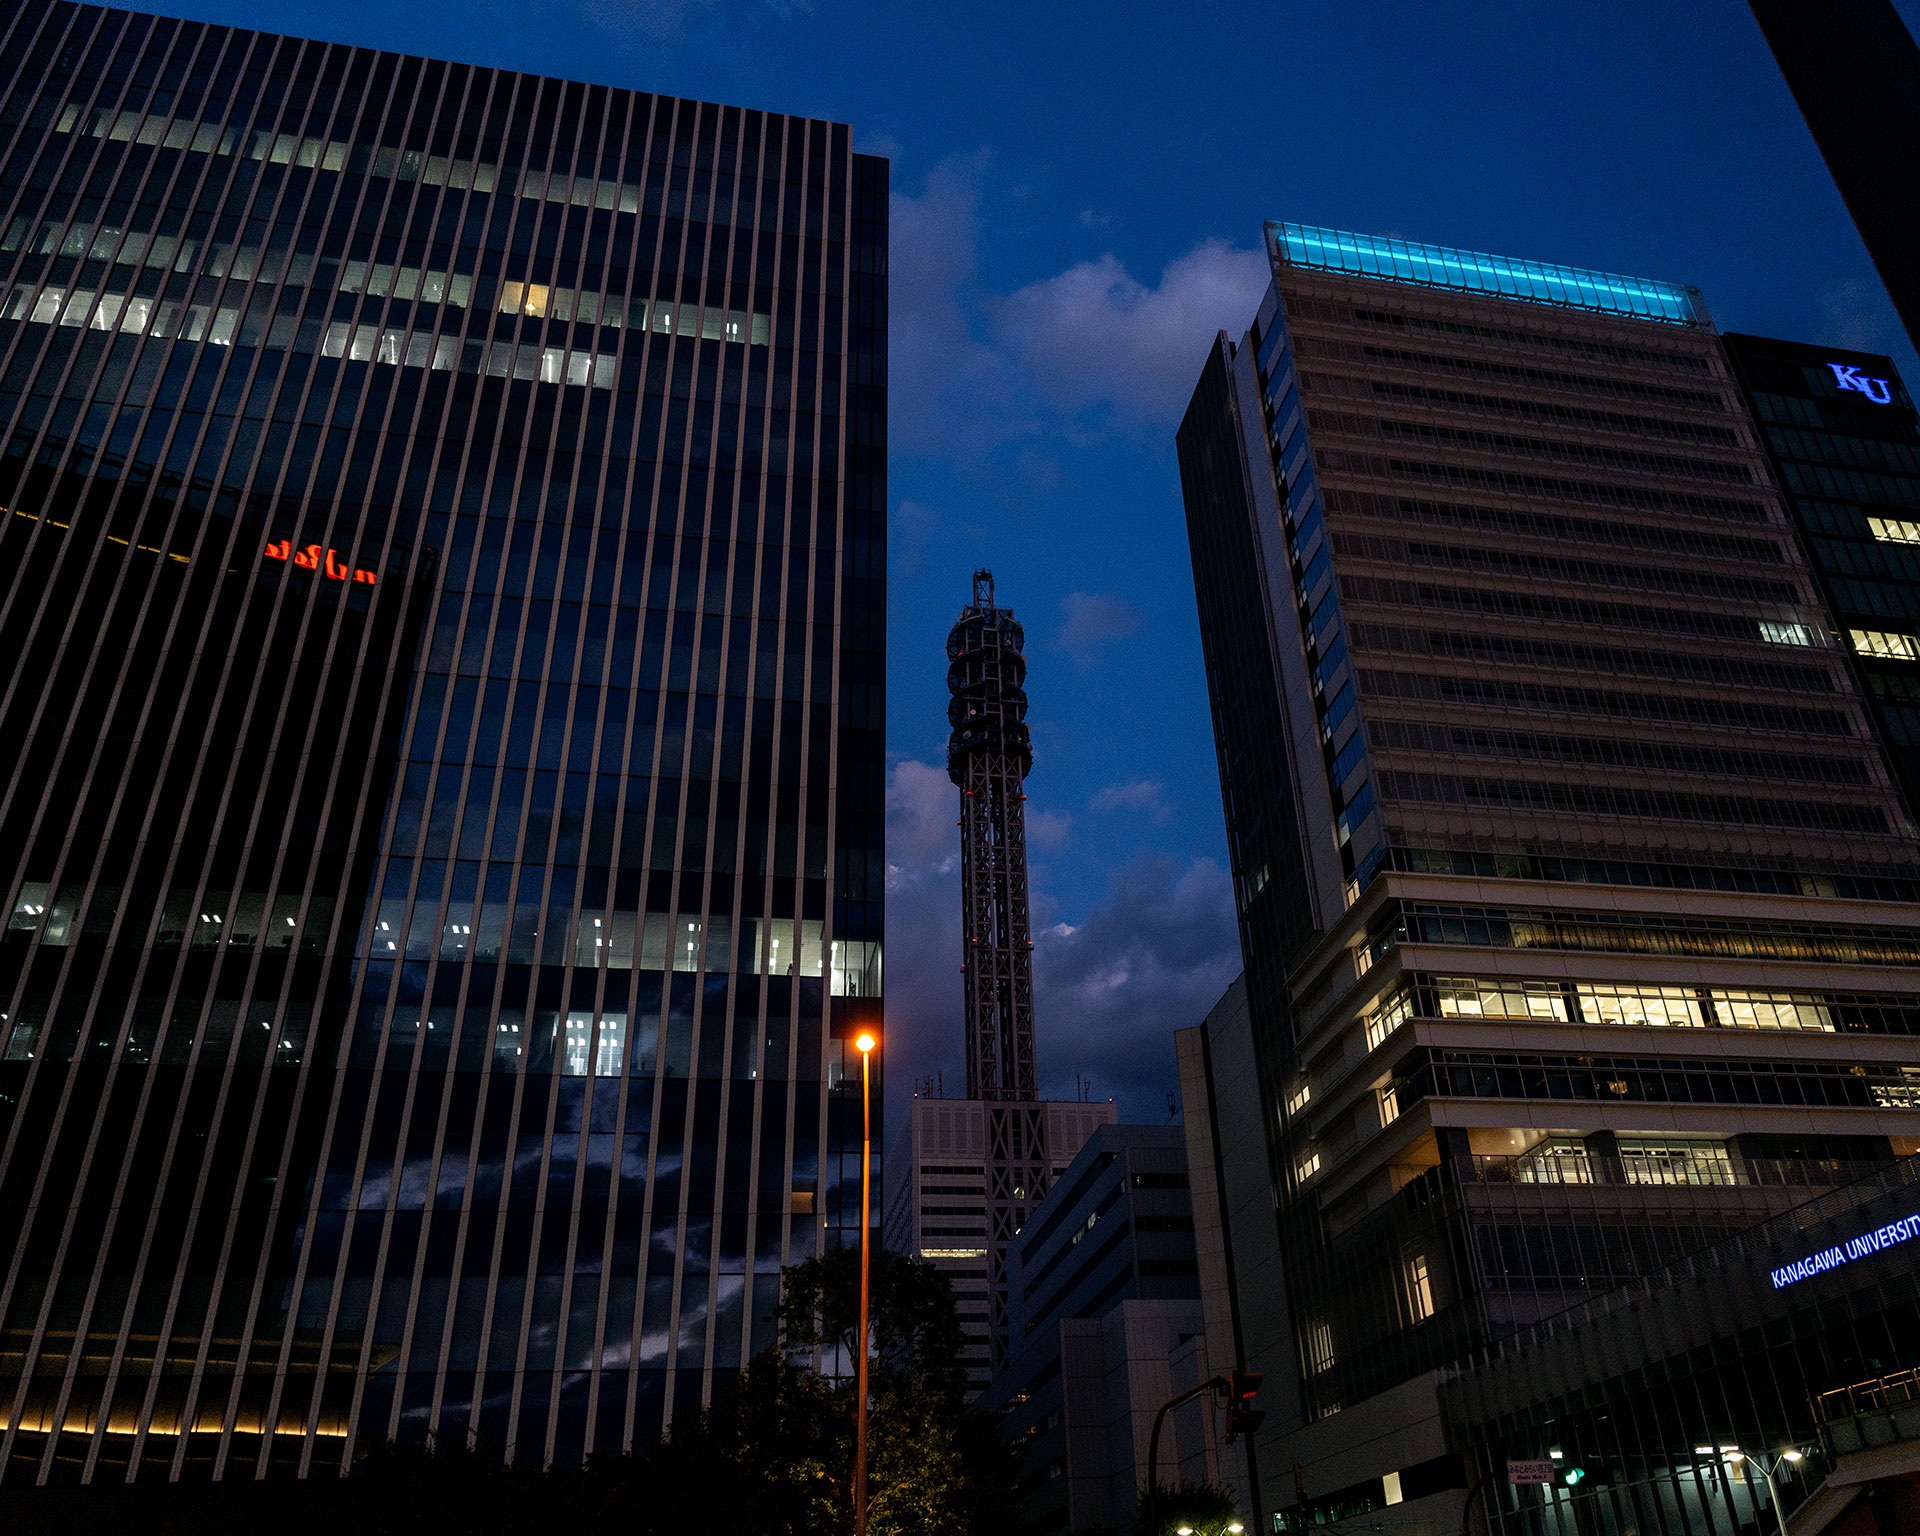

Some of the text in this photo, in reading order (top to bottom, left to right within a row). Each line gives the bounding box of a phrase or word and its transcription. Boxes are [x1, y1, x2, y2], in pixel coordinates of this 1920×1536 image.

[1826, 363, 1892, 405] KU
[1771, 1214, 1920, 1289] KANAGAWA UNIVERSIT
